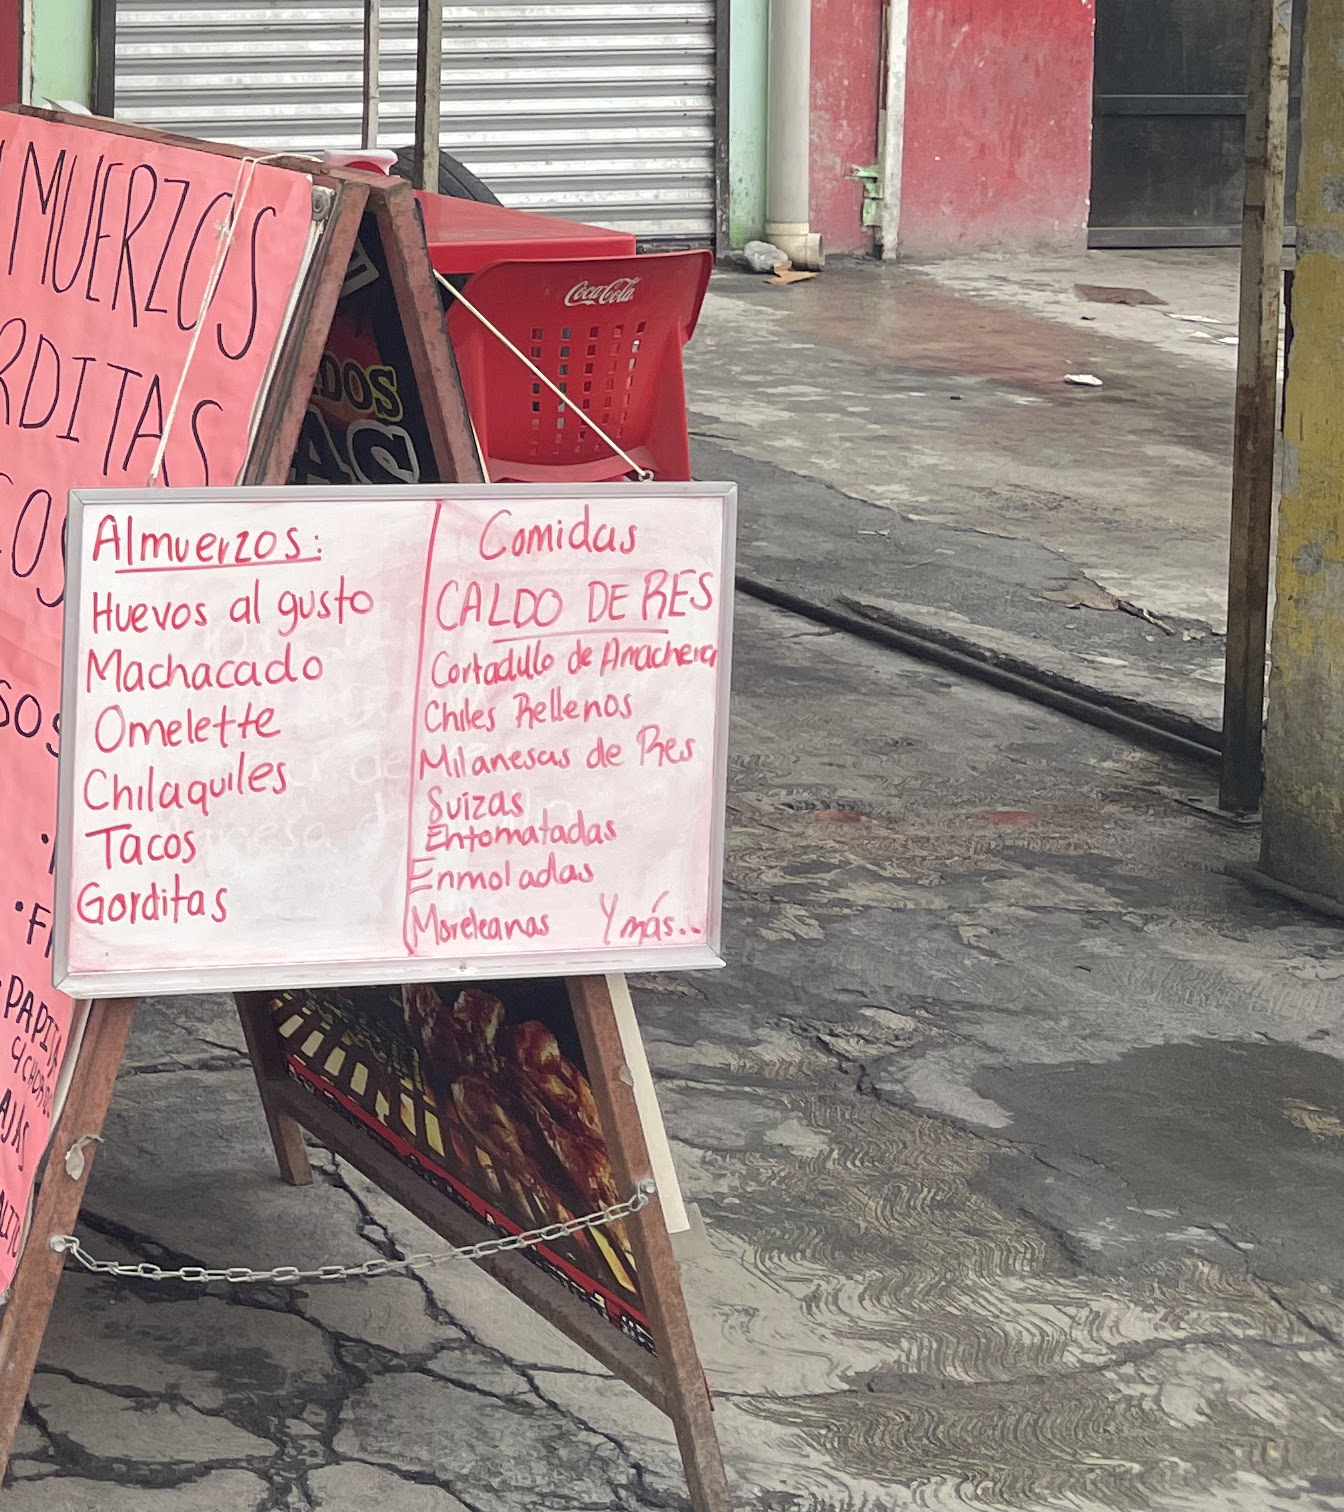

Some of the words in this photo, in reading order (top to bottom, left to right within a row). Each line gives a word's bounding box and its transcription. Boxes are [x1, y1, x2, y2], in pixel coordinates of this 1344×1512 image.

[564, 276, 643, 307] Coca-Cola
[92, 514, 323, 567] Almuerzos:
[479, 503, 638, 561] Comidas
[93, 591, 208, 634] Huevos
[229, 578, 261, 624] al
[277, 575, 375, 637] gusto
[436, 579, 563, 631] CALDO
[587, 580, 631, 623] DE
[641, 568, 714, 621] RES
[86, 642, 324, 693] Machacado
[567, 638, 593, 676] de
[95, 702, 282, 754] Omelette
[424, 697, 497, 734] Chiles
[512, 686, 633, 730] Rellenos
[419, 743, 572, 781] Milanesas
[585, 736, 625, 770] de
[636, 723, 697, 768] Res
[83, 751, 288, 816] Chilaquiles
[425, 785, 525, 825] Suizas
[85, 823, 197, 870] Tacos
[76, 873, 229, 926] Gorditas
[599, 892, 619, 945] Y
